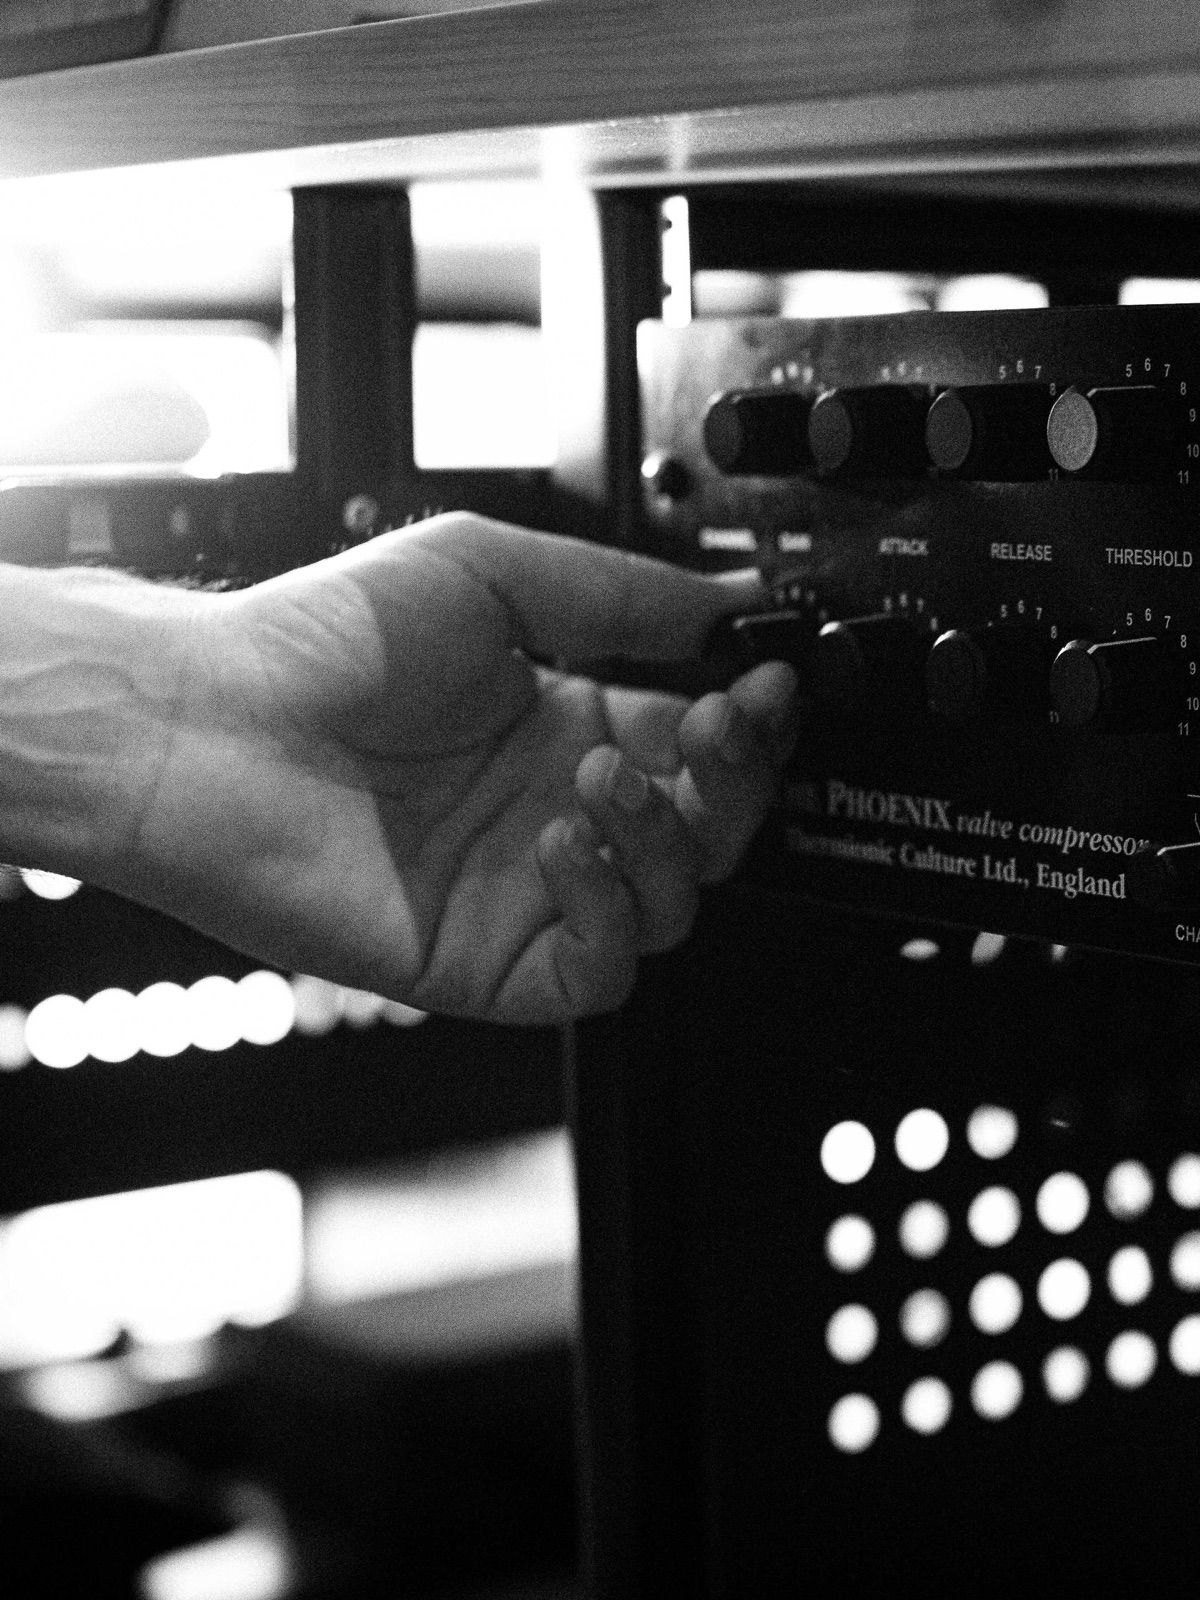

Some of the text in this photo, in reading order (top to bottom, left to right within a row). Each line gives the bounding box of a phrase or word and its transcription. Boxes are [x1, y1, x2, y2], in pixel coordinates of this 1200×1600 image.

[1034, 364, 1043, 379] 7
[1125, 357, 1172, 378] 5 6 7
[1179, 381, 1187, 396] 8
[1188, 407, 1197, 423] 9
[1186, 443, 1200, 459] 10
[1177, 469, 1190, 484] 11
[991, 543, 1052, 561] RELEASE
[1105, 548, 1192, 567] THRESHOLD
[1000, 599, 1043, 620] 5 6 7
[1125, 607, 1172, 629] 5 6 7
[1179, 633, 1188, 649] 8
[1188, 660, 1197, 676] 9
[1186, 696, 1200, 712] 10
[1177, 721, 1190, 736] 11
[827, 779, 951, 831] PHOENIX
[957, 811, 1013, 839] valve
[900, 844, 976, 877] Culture
[1037, 863, 1126, 899] England
